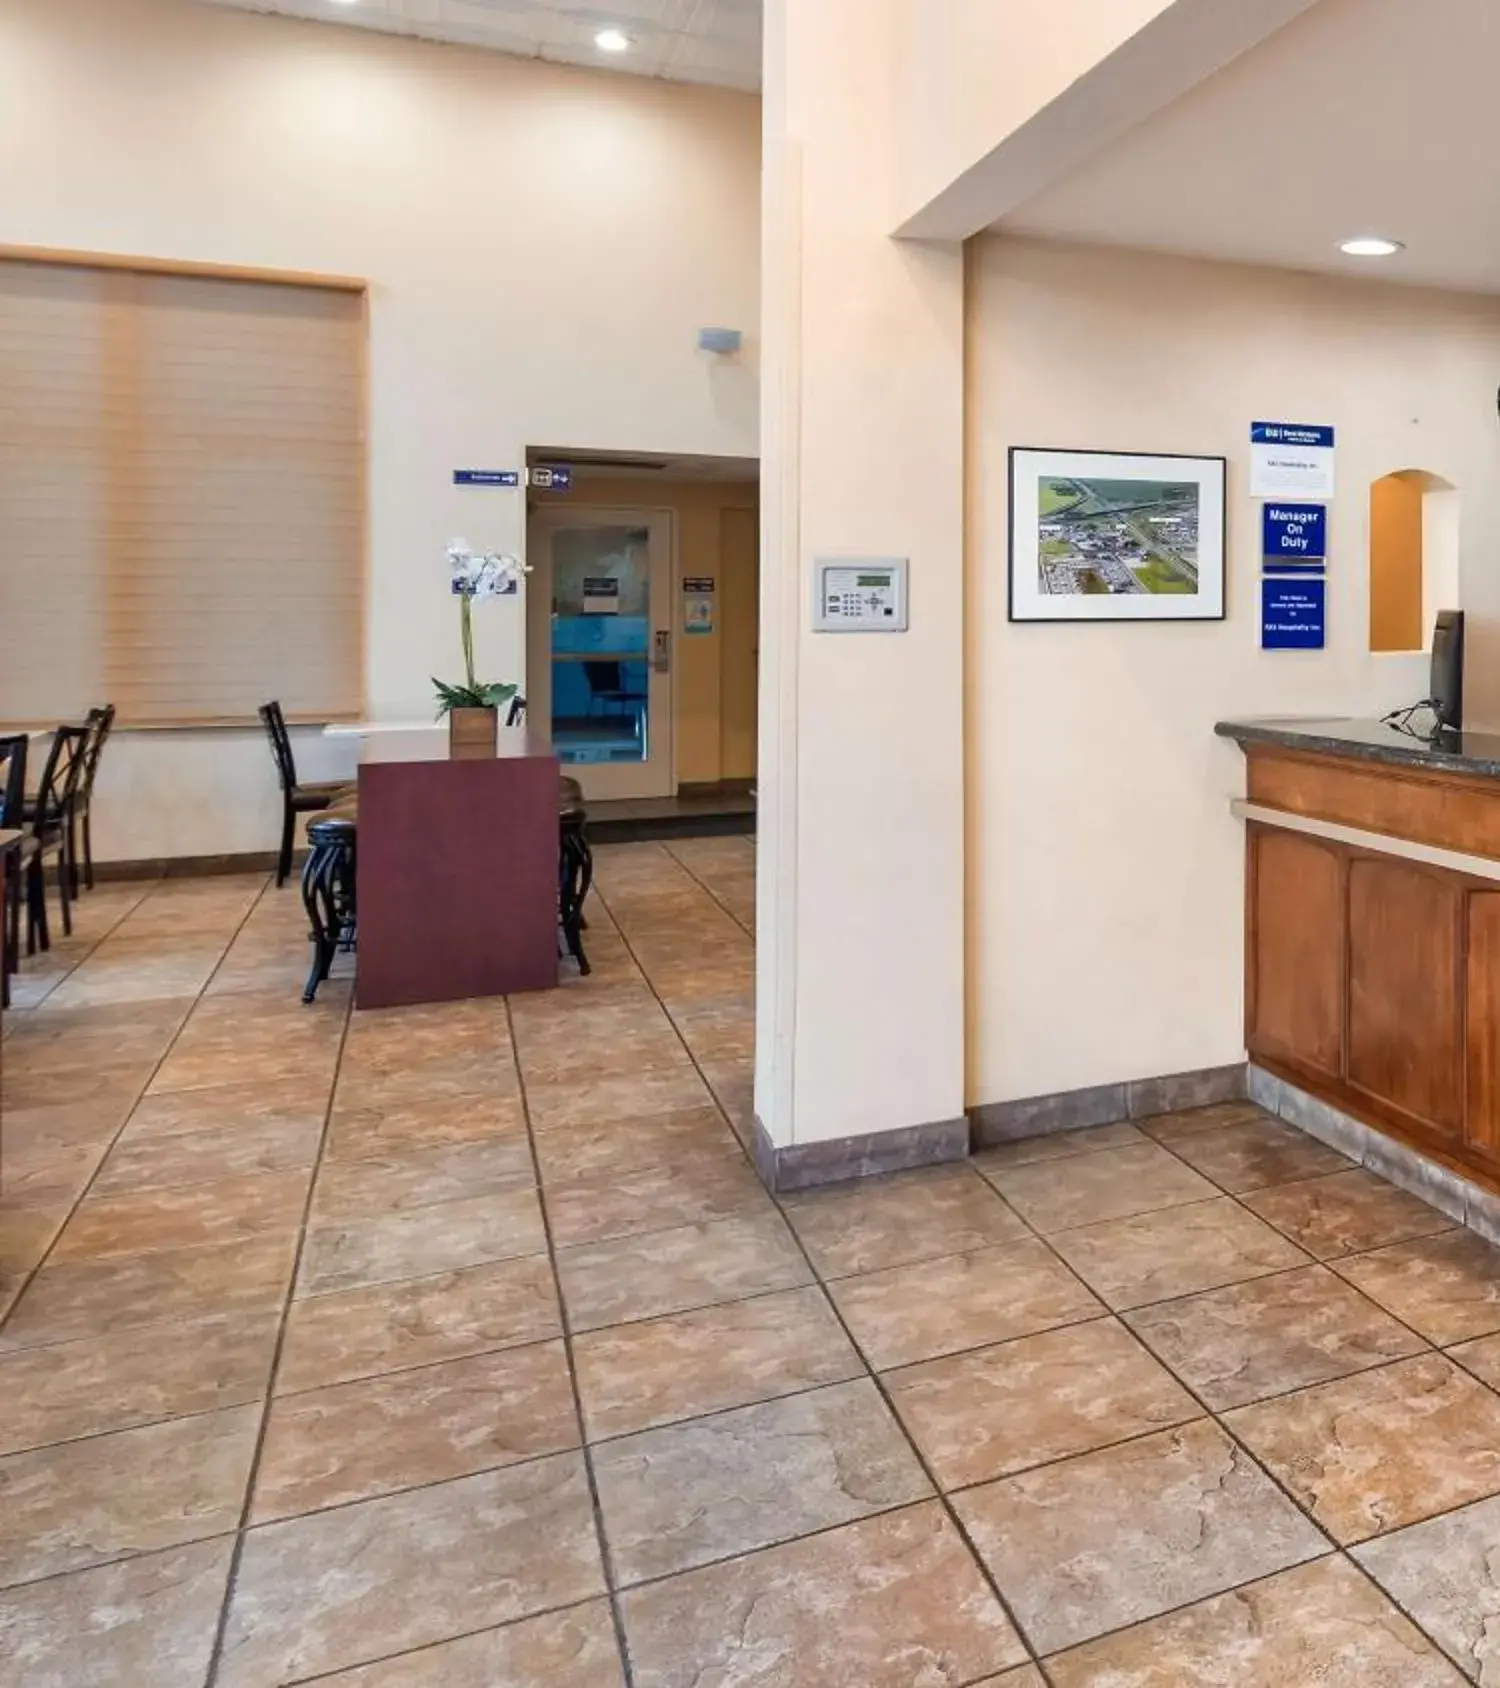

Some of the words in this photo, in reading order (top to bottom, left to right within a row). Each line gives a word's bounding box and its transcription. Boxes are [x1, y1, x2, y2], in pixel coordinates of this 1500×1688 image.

[1269, 509, 1319, 524] Manager
[1287, 523, 1303, 535] On
[1281, 535, 1309, 551] Duty
